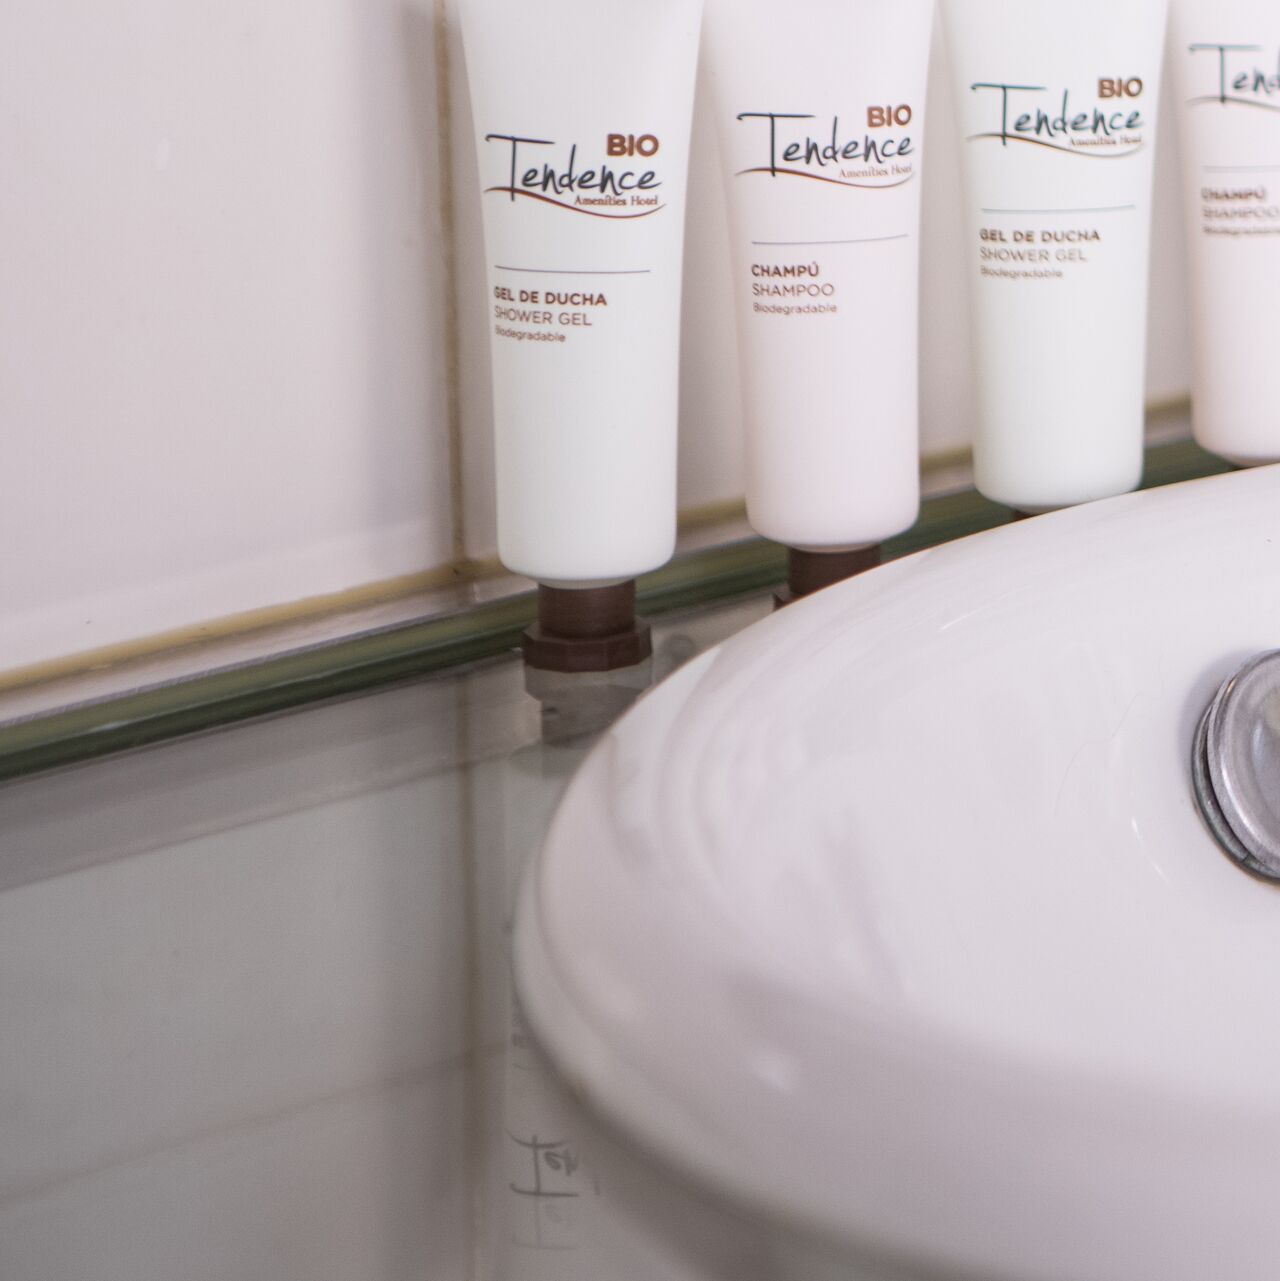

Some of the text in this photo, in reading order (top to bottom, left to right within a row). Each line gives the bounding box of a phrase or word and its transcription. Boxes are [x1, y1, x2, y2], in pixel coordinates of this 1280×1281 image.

[1098, 77, 1143, 98] BIO
[867, 104, 912, 128] BIO
[971, 83, 1145, 147] Tendence
[607, 133, 659, 157] BIO
[737, 112, 913, 177] Tendence
[485, 134, 662, 202] Tendence
[979, 228, 1101, 243] GEL DE DUCHA
[979, 246, 1087, 262] SHOWER GEL
[751, 260, 819, 277] CHAMPÚ
[494, 286, 608, 306] GEL DE DUCHA
[752, 283, 834, 297] SHAMPOO
[494, 305, 592, 326] SHOWER GEL
[753, 302, 837, 315] Biodegradable
[495, 325, 566, 342] Biodegradable
